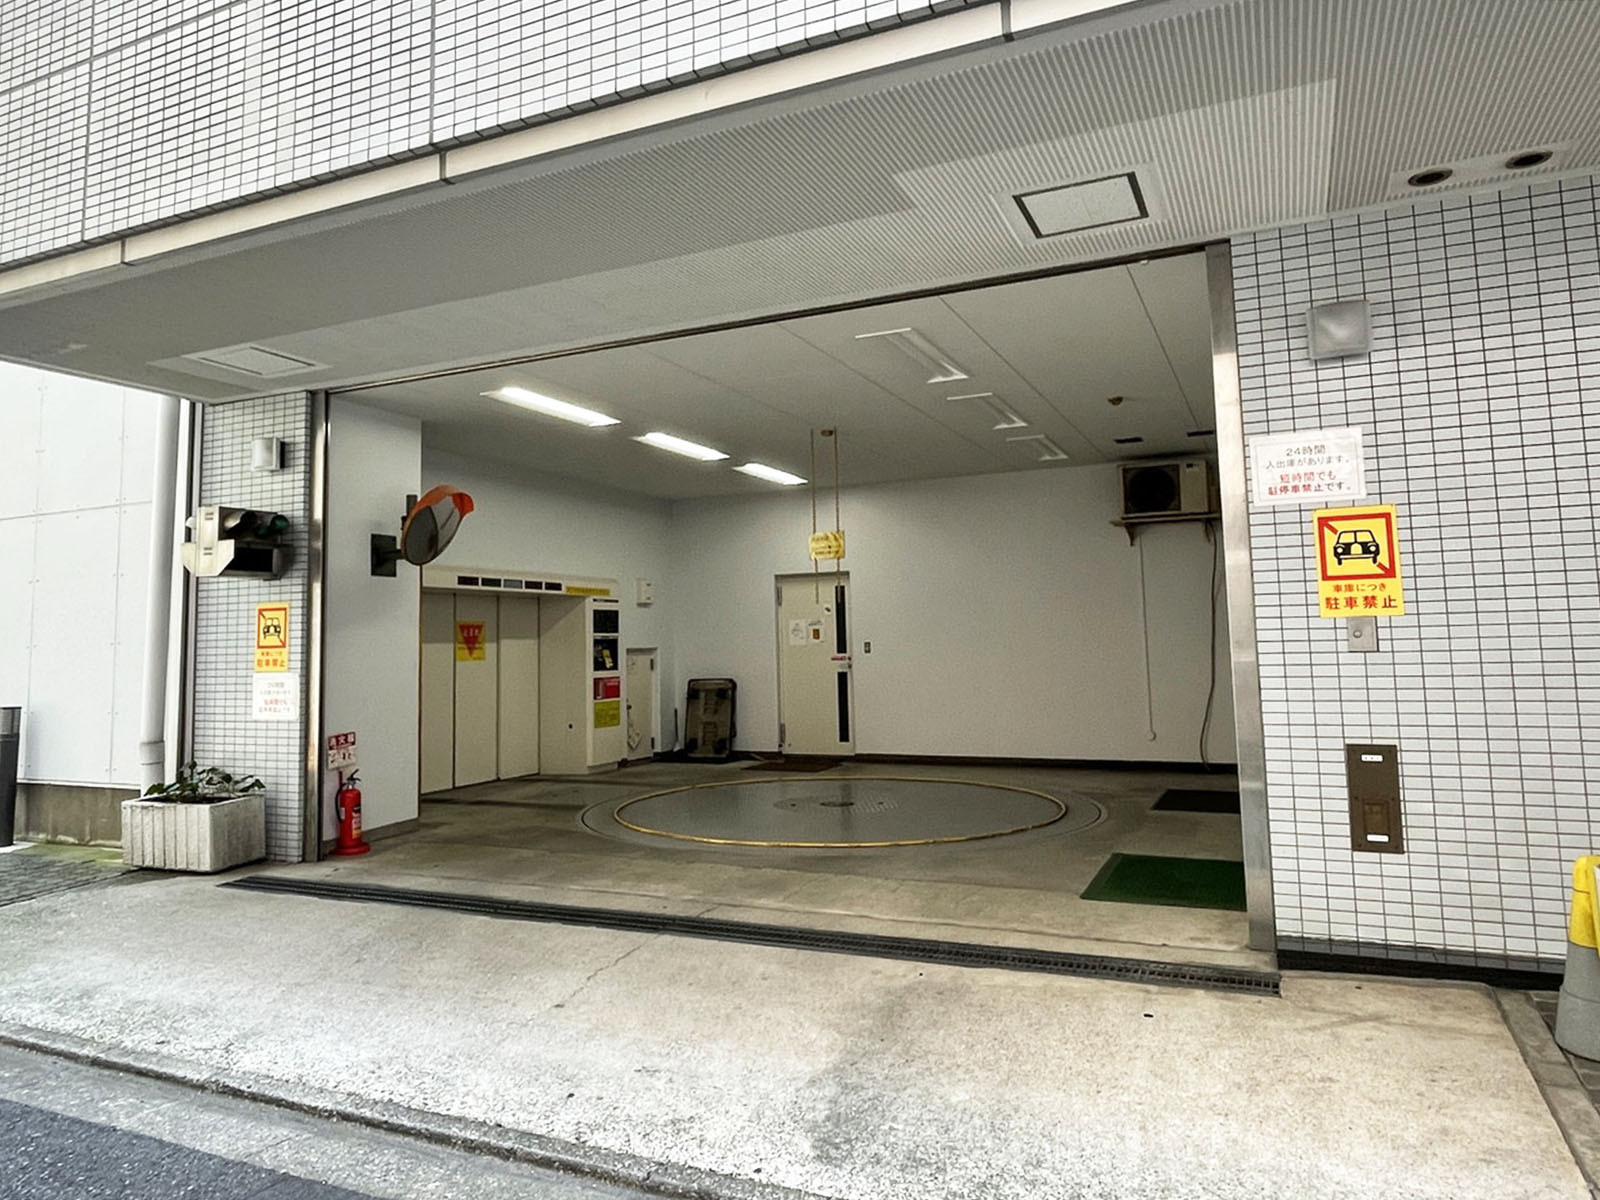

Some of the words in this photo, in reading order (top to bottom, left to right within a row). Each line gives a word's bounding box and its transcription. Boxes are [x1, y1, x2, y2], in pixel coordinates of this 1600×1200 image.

[1286, 444, 1326, 456] 24時間
[1280, 470, 1336, 484] 短時間でも
[1332, 583, 1387, 593] 車庫につき
[1325, 595, 1398, 610] 駐車禁止
